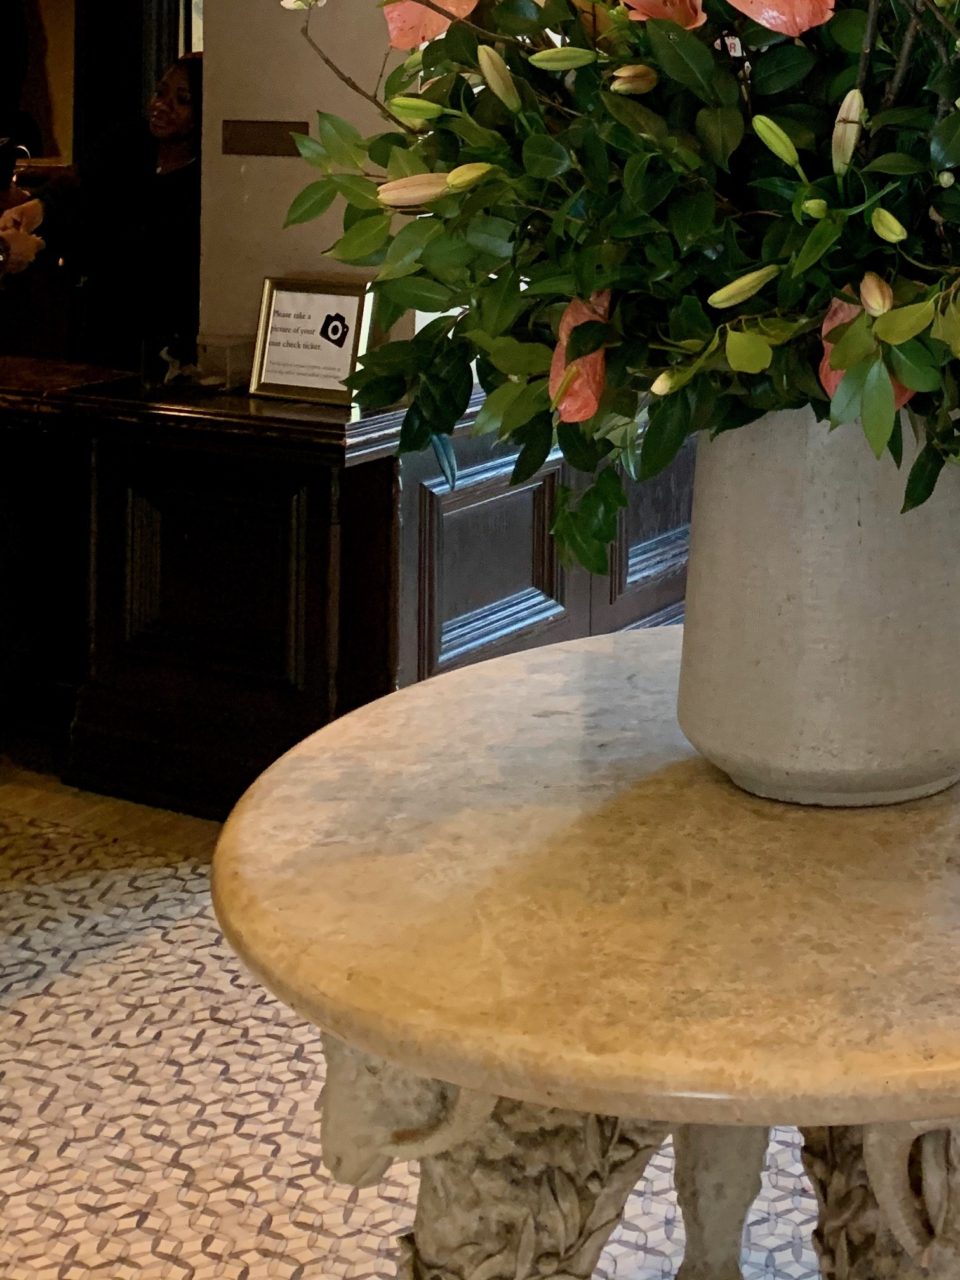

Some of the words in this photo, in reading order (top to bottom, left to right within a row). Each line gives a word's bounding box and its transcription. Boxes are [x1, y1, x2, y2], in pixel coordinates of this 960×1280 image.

[273, 310, 292, 318] Please
[293, 312, 306, 320] take
[292, 326, 301, 334] of
[301, 328, 316, 337] your
[282, 340, 301, 349] check
